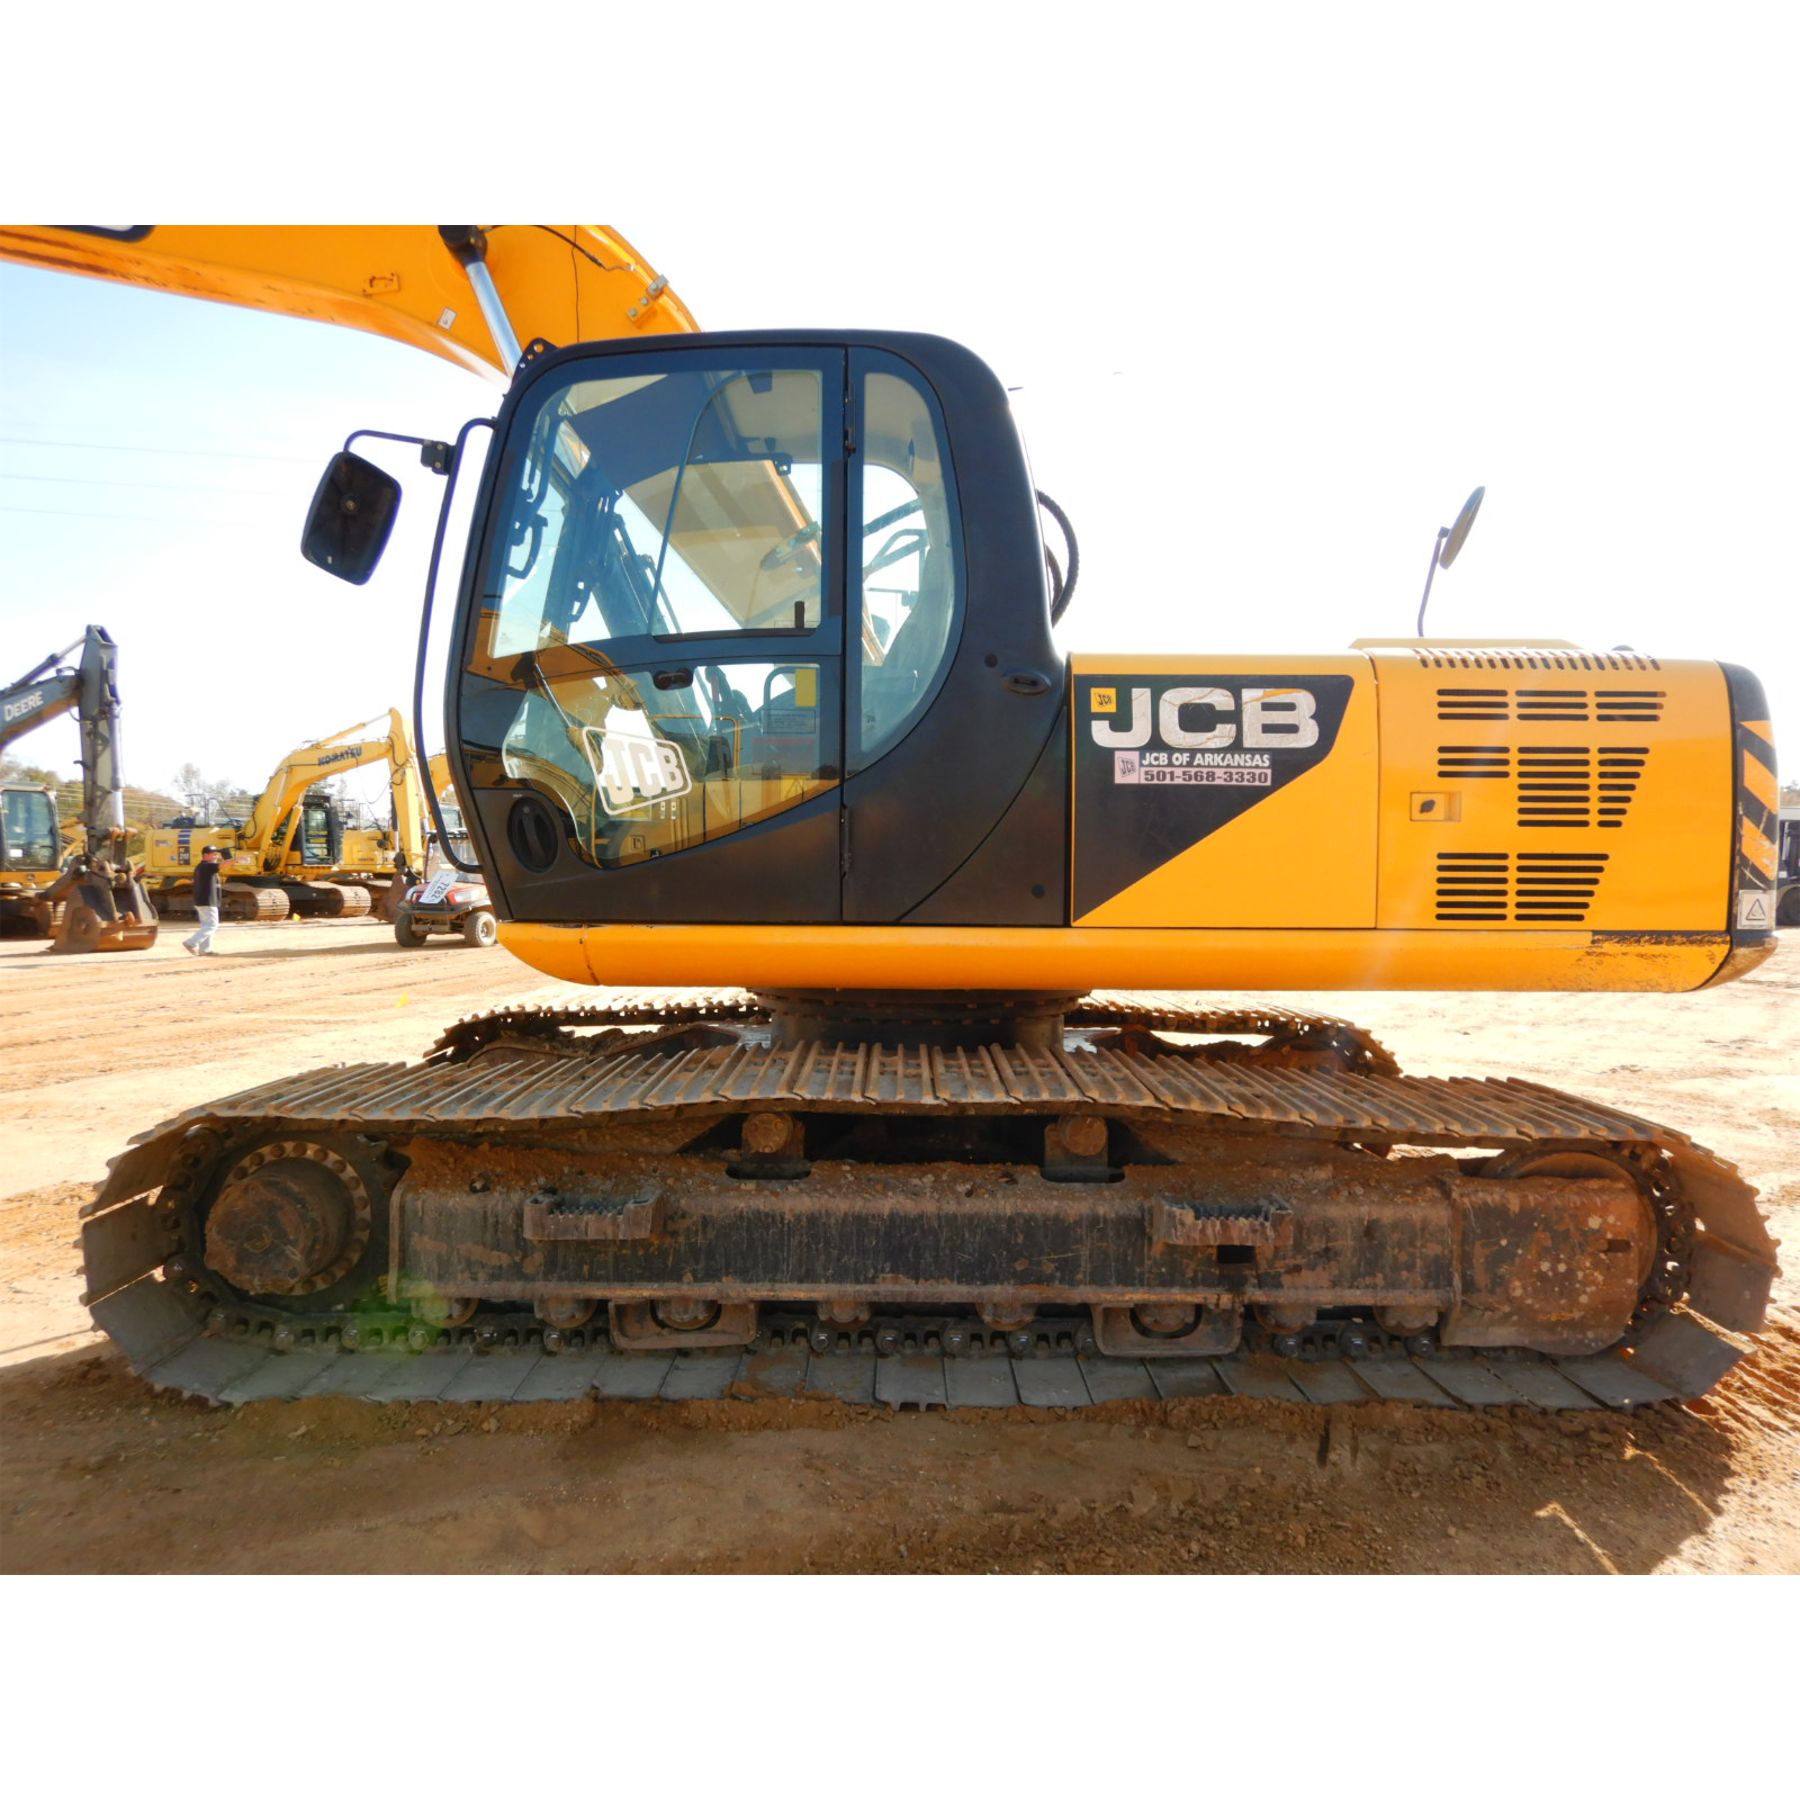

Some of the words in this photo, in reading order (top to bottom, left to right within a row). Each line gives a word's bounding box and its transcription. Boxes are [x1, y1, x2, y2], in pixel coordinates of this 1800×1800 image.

[4, 691, 44, 722] DEERE
[1091, 687, 1319, 748] JCB
[318, 745, 363, 766] KOMATSU
[1142, 752, 1168, 766] JCB
[1172, 752, 1190, 766] OF
[1193, 753, 1271, 767] ARKANSAS
[603, 739, 684, 804] JCB
[1144, 770, 1269, 784] 501-568-3330
